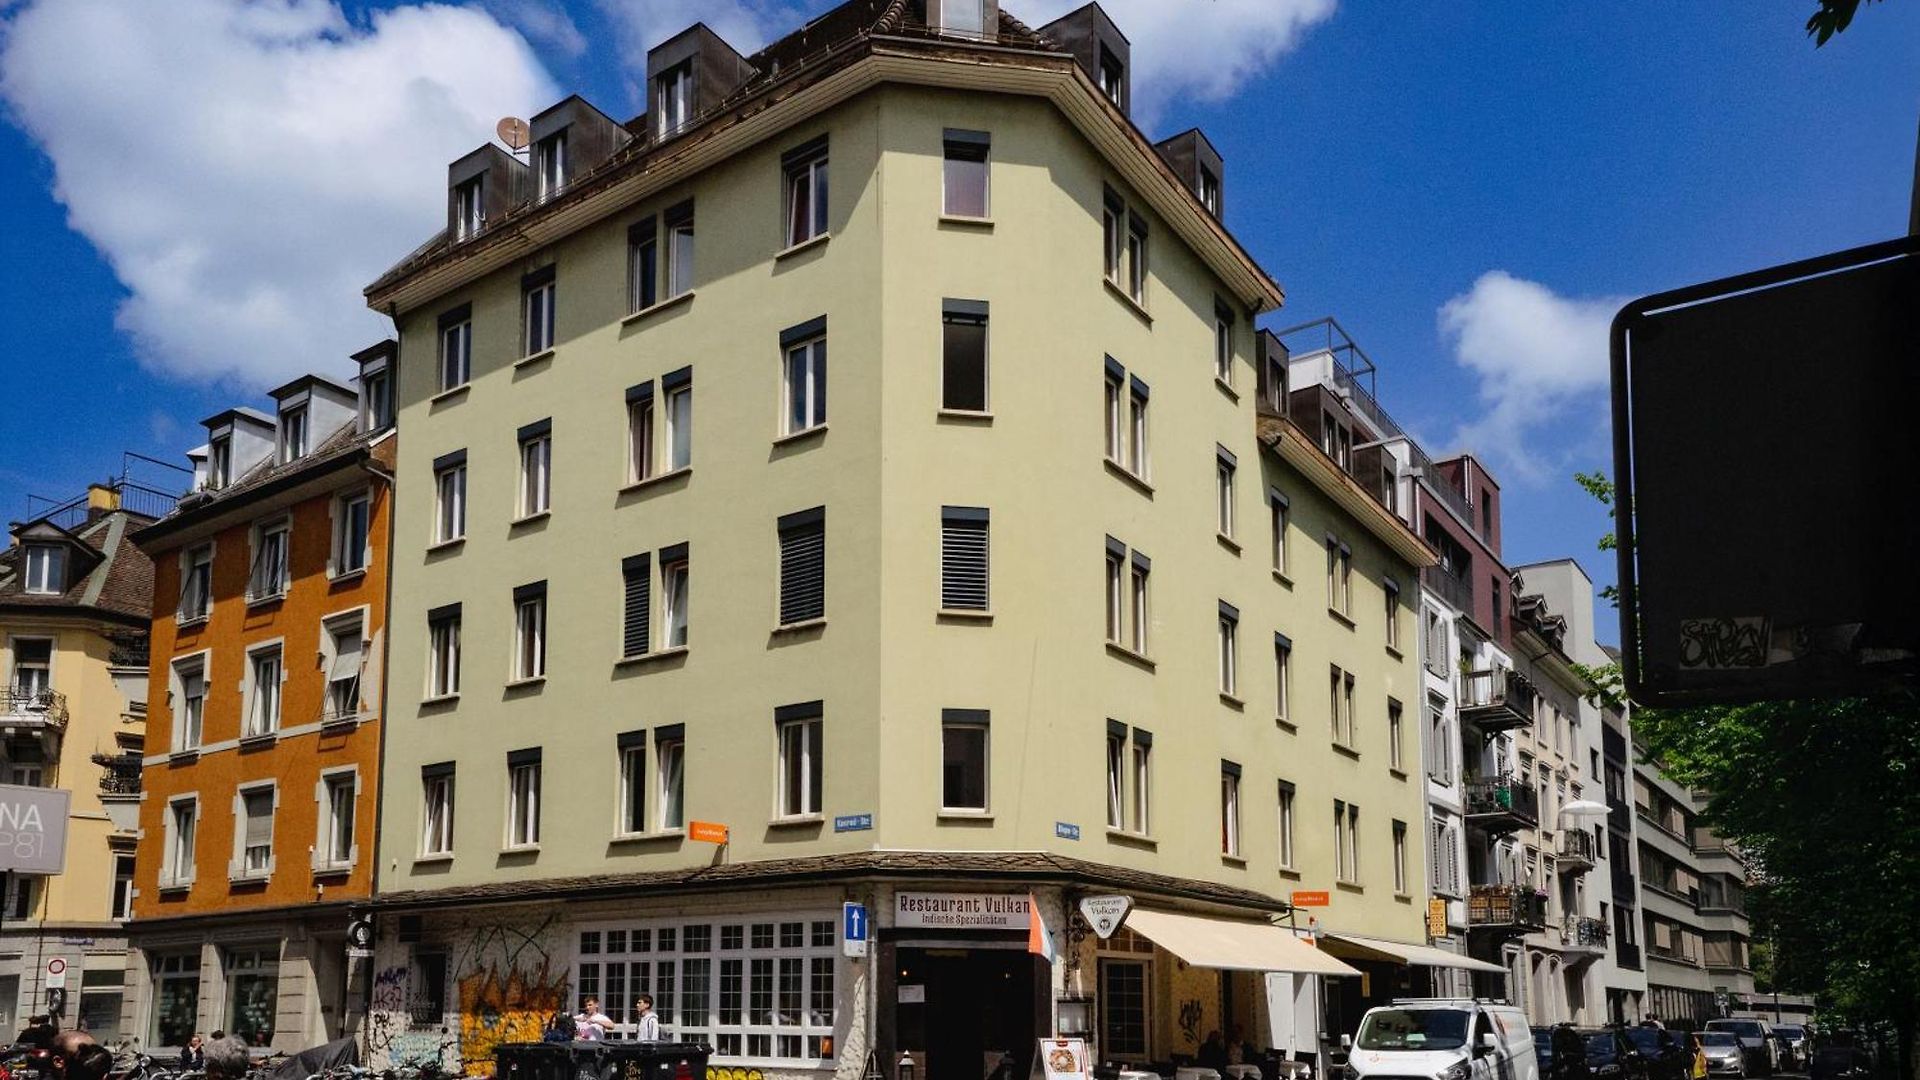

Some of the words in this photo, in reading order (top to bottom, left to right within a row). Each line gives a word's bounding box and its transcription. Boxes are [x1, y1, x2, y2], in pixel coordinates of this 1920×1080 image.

[0, 802, 44, 832] NA
[900, 895, 981, 912] Restaurant
[985, 897, 1030, 913] Vulkan
[1091, 905, 1120, 914] Vulkan
[922, 914, 954, 924] Indische
[956, 914, 1007, 926] Spezialitäten
